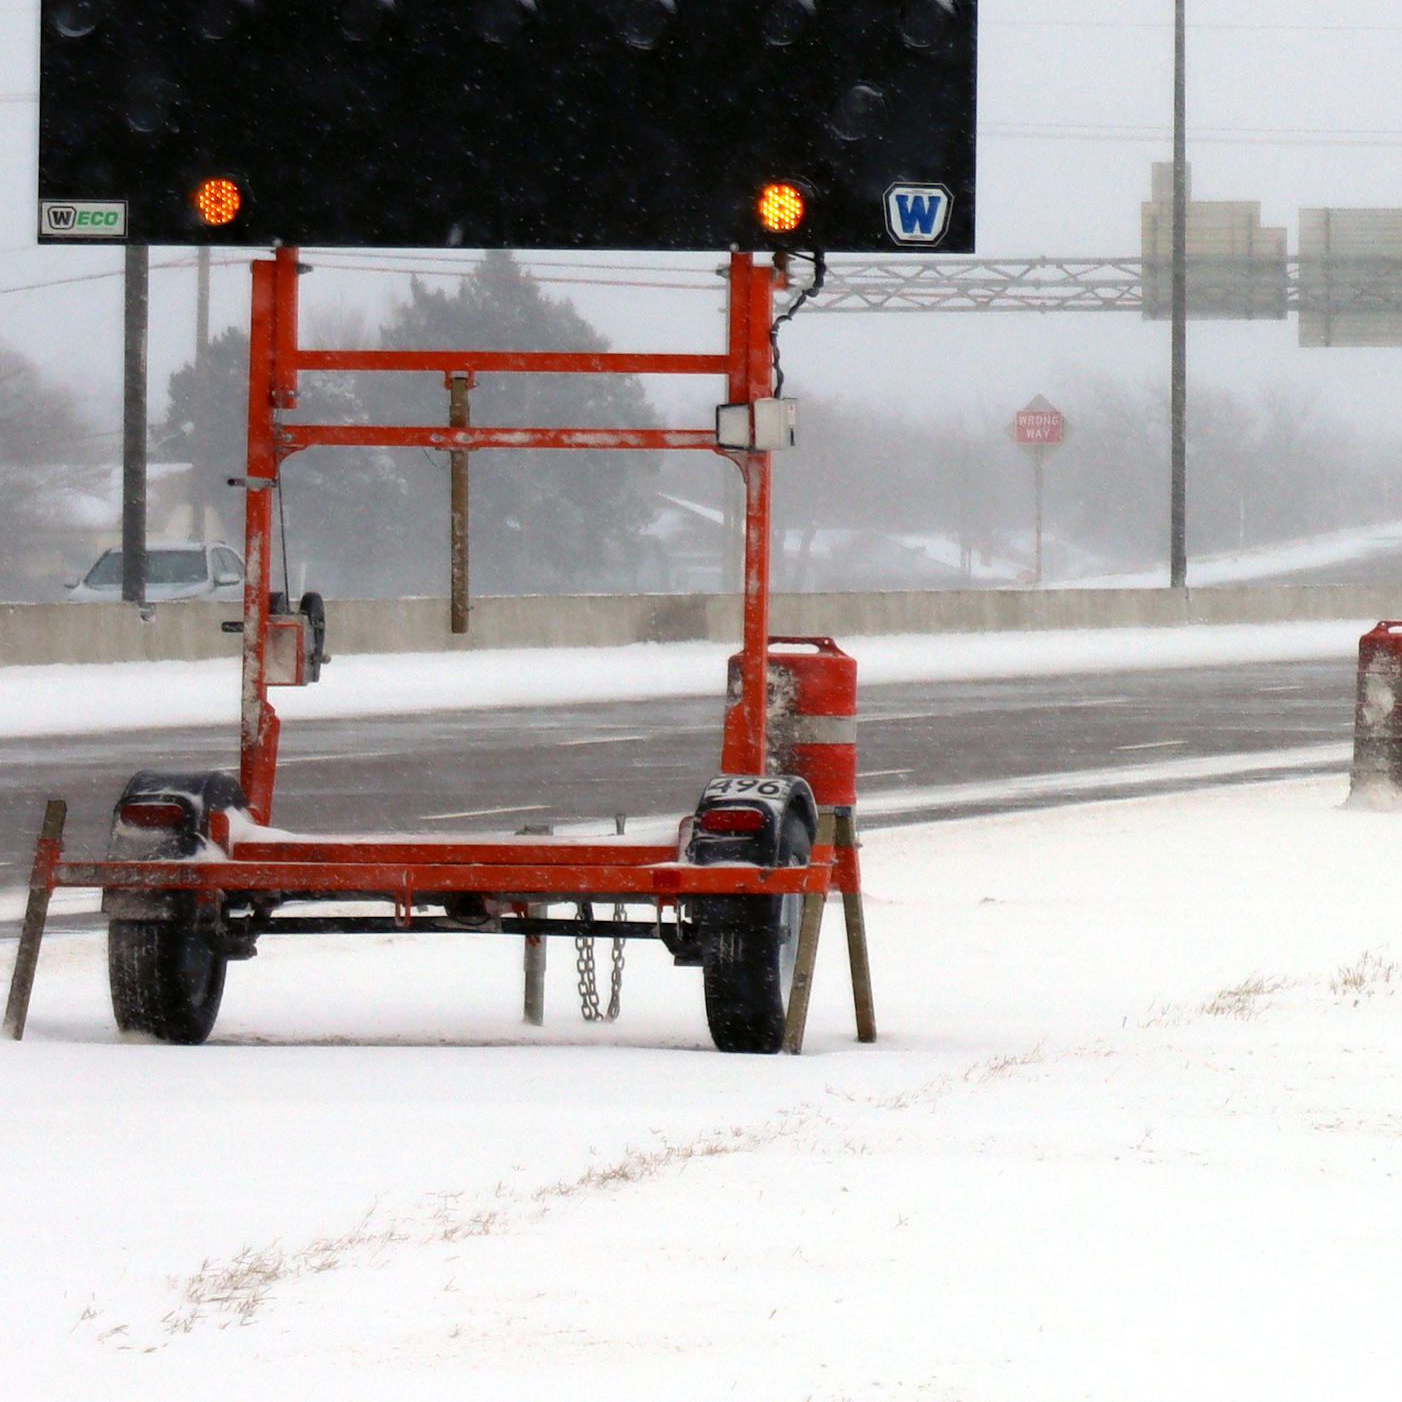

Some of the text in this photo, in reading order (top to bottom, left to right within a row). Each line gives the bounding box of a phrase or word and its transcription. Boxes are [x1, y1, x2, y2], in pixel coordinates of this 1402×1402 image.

[895, 194, 941, 235] W
[1018, 415, 1059, 426] WRONG
[1026, 428, 1050, 439] WAY
[708, 779, 781, 795] 496
